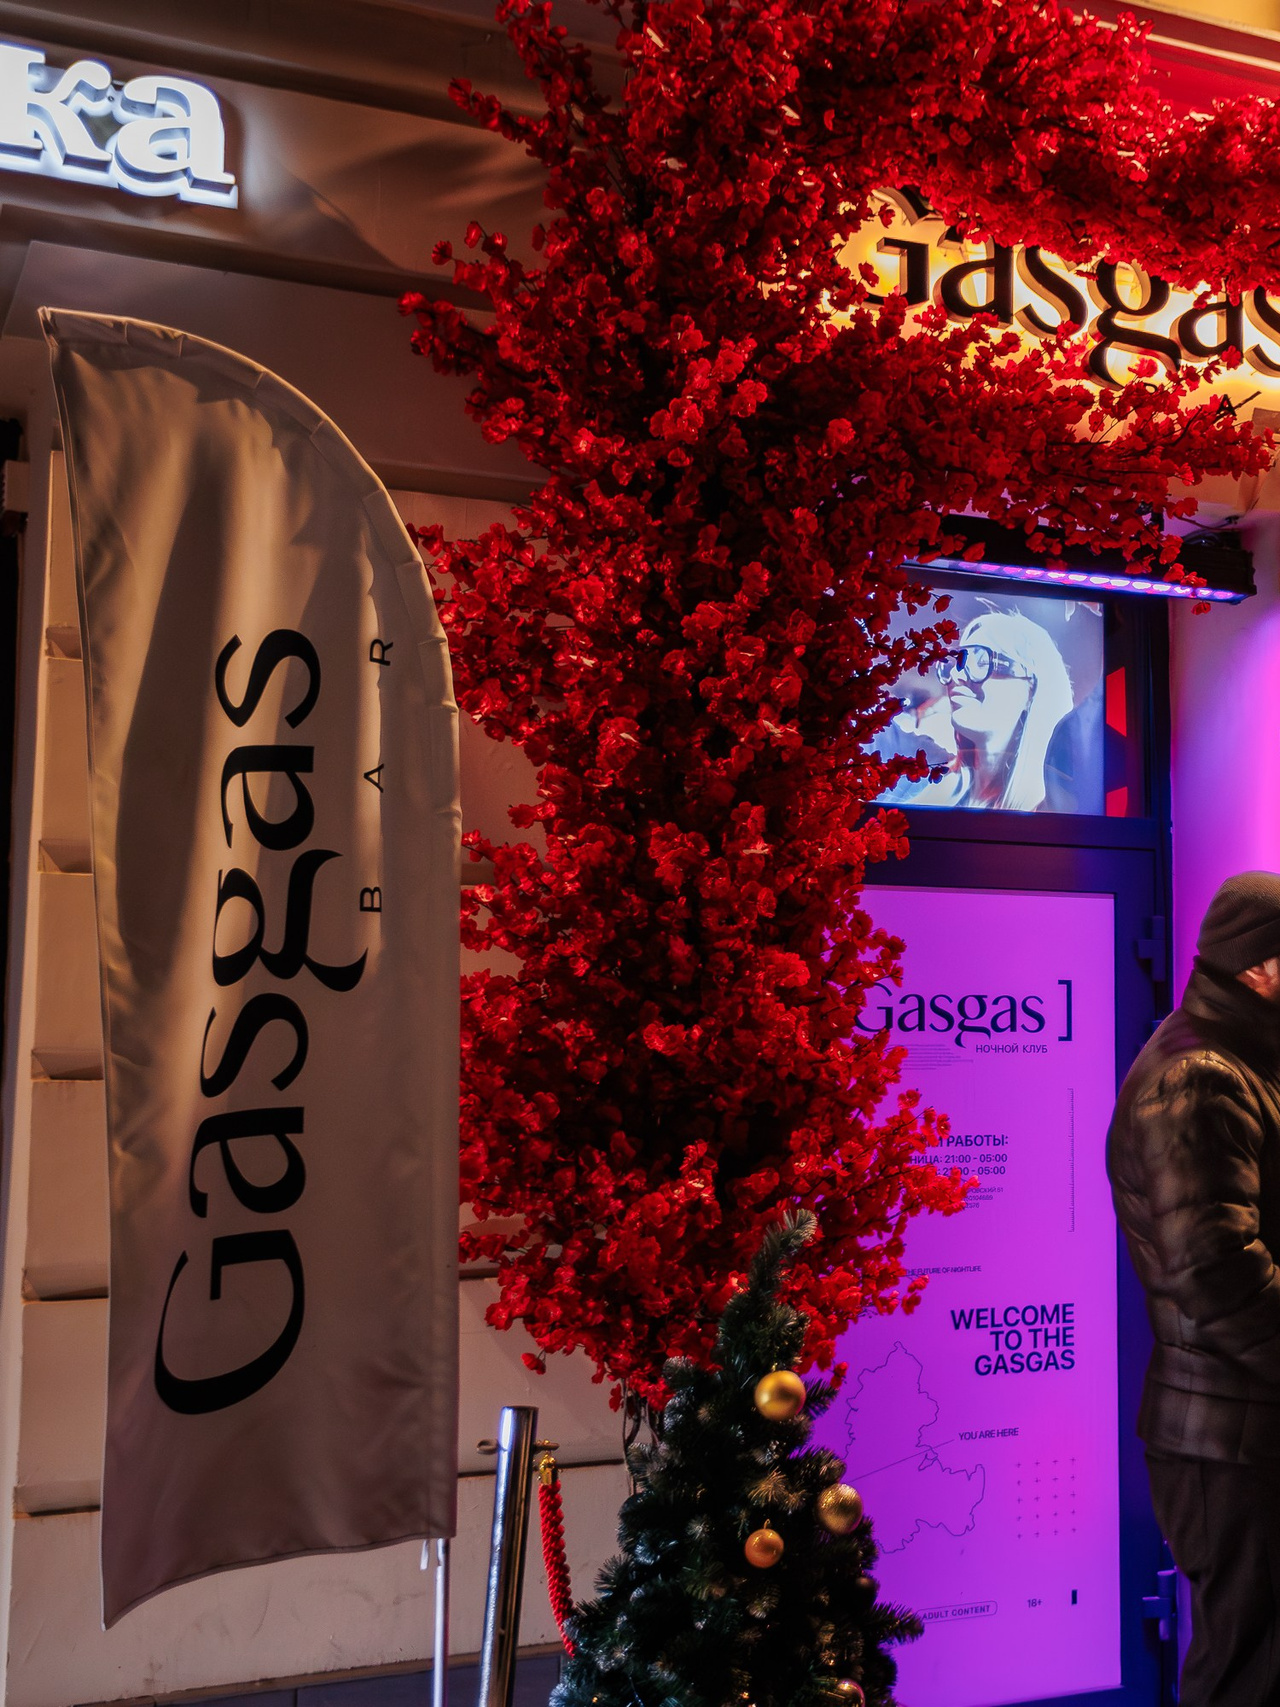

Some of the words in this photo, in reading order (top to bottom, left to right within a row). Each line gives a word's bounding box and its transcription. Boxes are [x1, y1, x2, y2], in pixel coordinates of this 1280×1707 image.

[359, 636, 394, 913] BAR
[154, 628, 368, 1415] Gasgas
[855, 982, 1046, 1049] Gasgas
[975, 1043, 1019, 1054] НОЧНОЙ
[1022, 1044, 1048, 1054] КЛУБ
[946, 1134, 1008, 1148] РАБОТЫ:
[909, 1155, 943, 1165] НИЦА:
[944, 1154, 971, 1164] 21:00
[979, 1153, 1008, 1163] 05:00
[977, 1165, 1006, 1175] 05:00
[950, 1303, 1075, 1331] WELCOME
[989, 1329, 1023, 1351] TO
[1028, 1326, 1075, 1349] THE
[974, 1349, 1076, 1376] GASGAS
[958, 1431, 978, 1441] YOU
[978, 1429, 996, 1439] ARE
[996, 1427, 1020, 1438] HERE
[1027, 1598, 1043, 1609] 18+
[922, 1609, 949, 1621] ADULT
[951, 1604, 991, 1617] CONTENT
